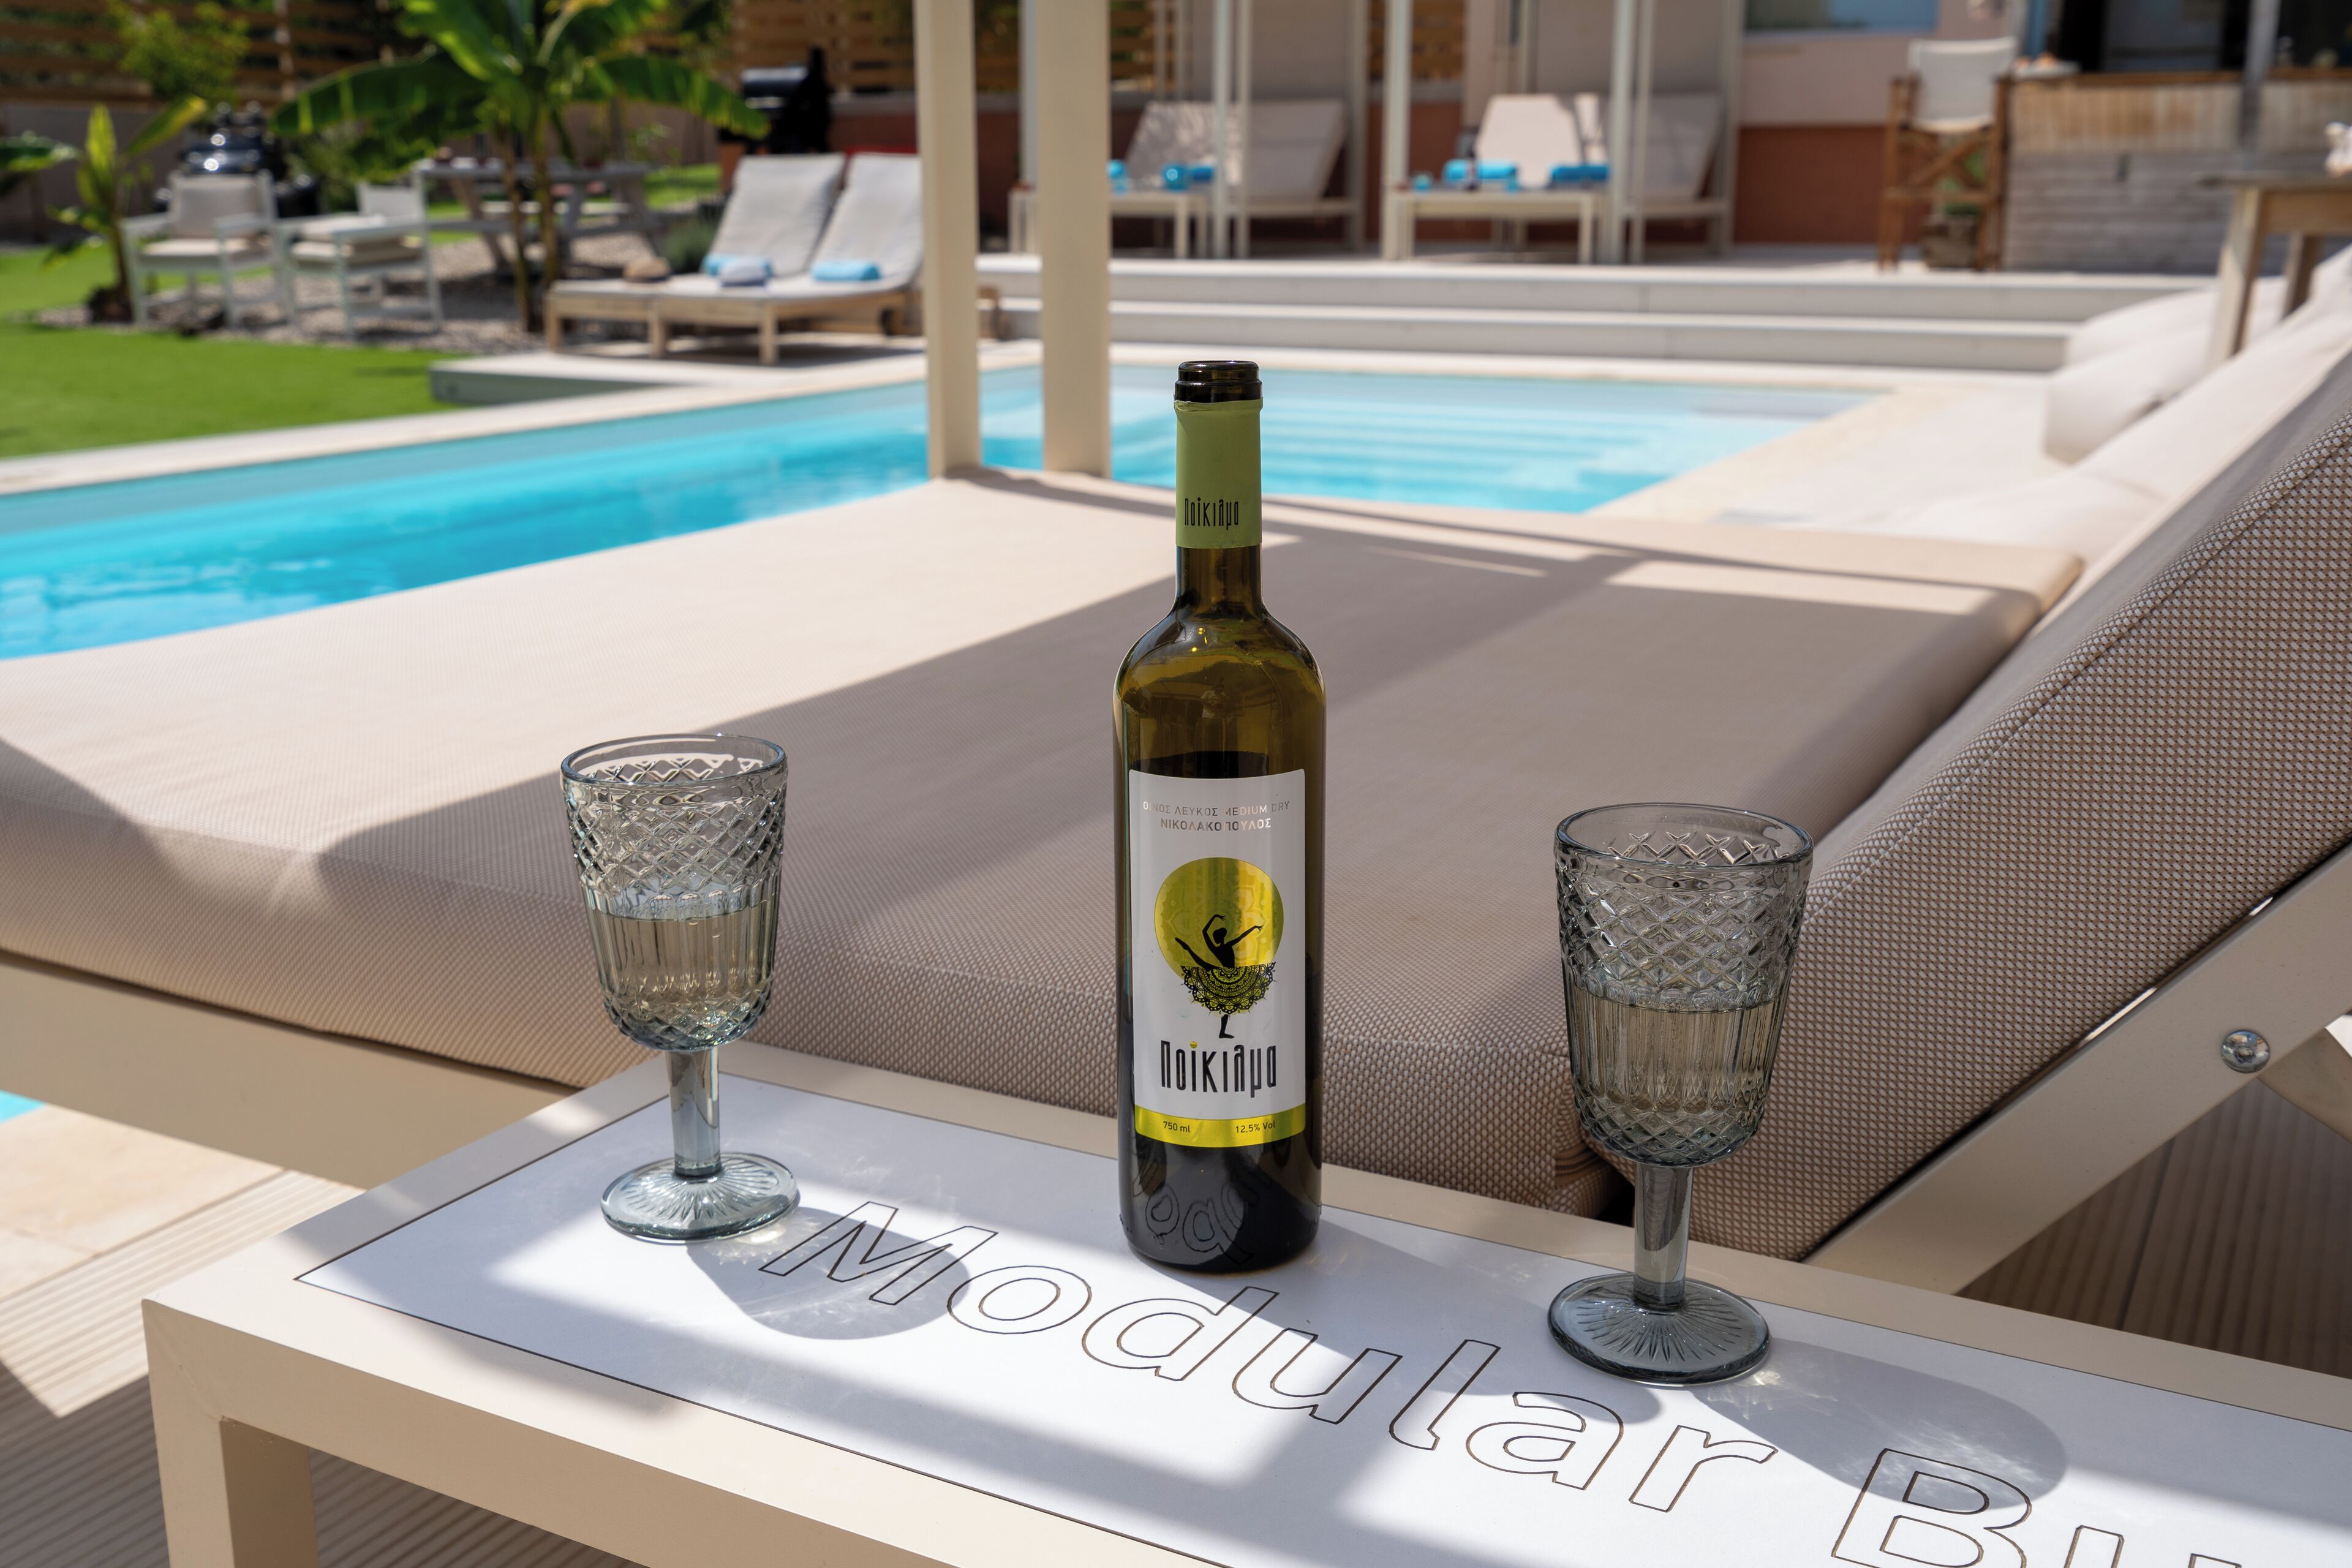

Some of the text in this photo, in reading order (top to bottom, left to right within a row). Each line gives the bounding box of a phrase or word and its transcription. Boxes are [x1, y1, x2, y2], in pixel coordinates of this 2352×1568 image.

[1163, 1121, 1177, 1131] 750
[1235, 1120, 1275, 1133] 12,5% Vol
[758, 1201, 1779, 1512] Modular
